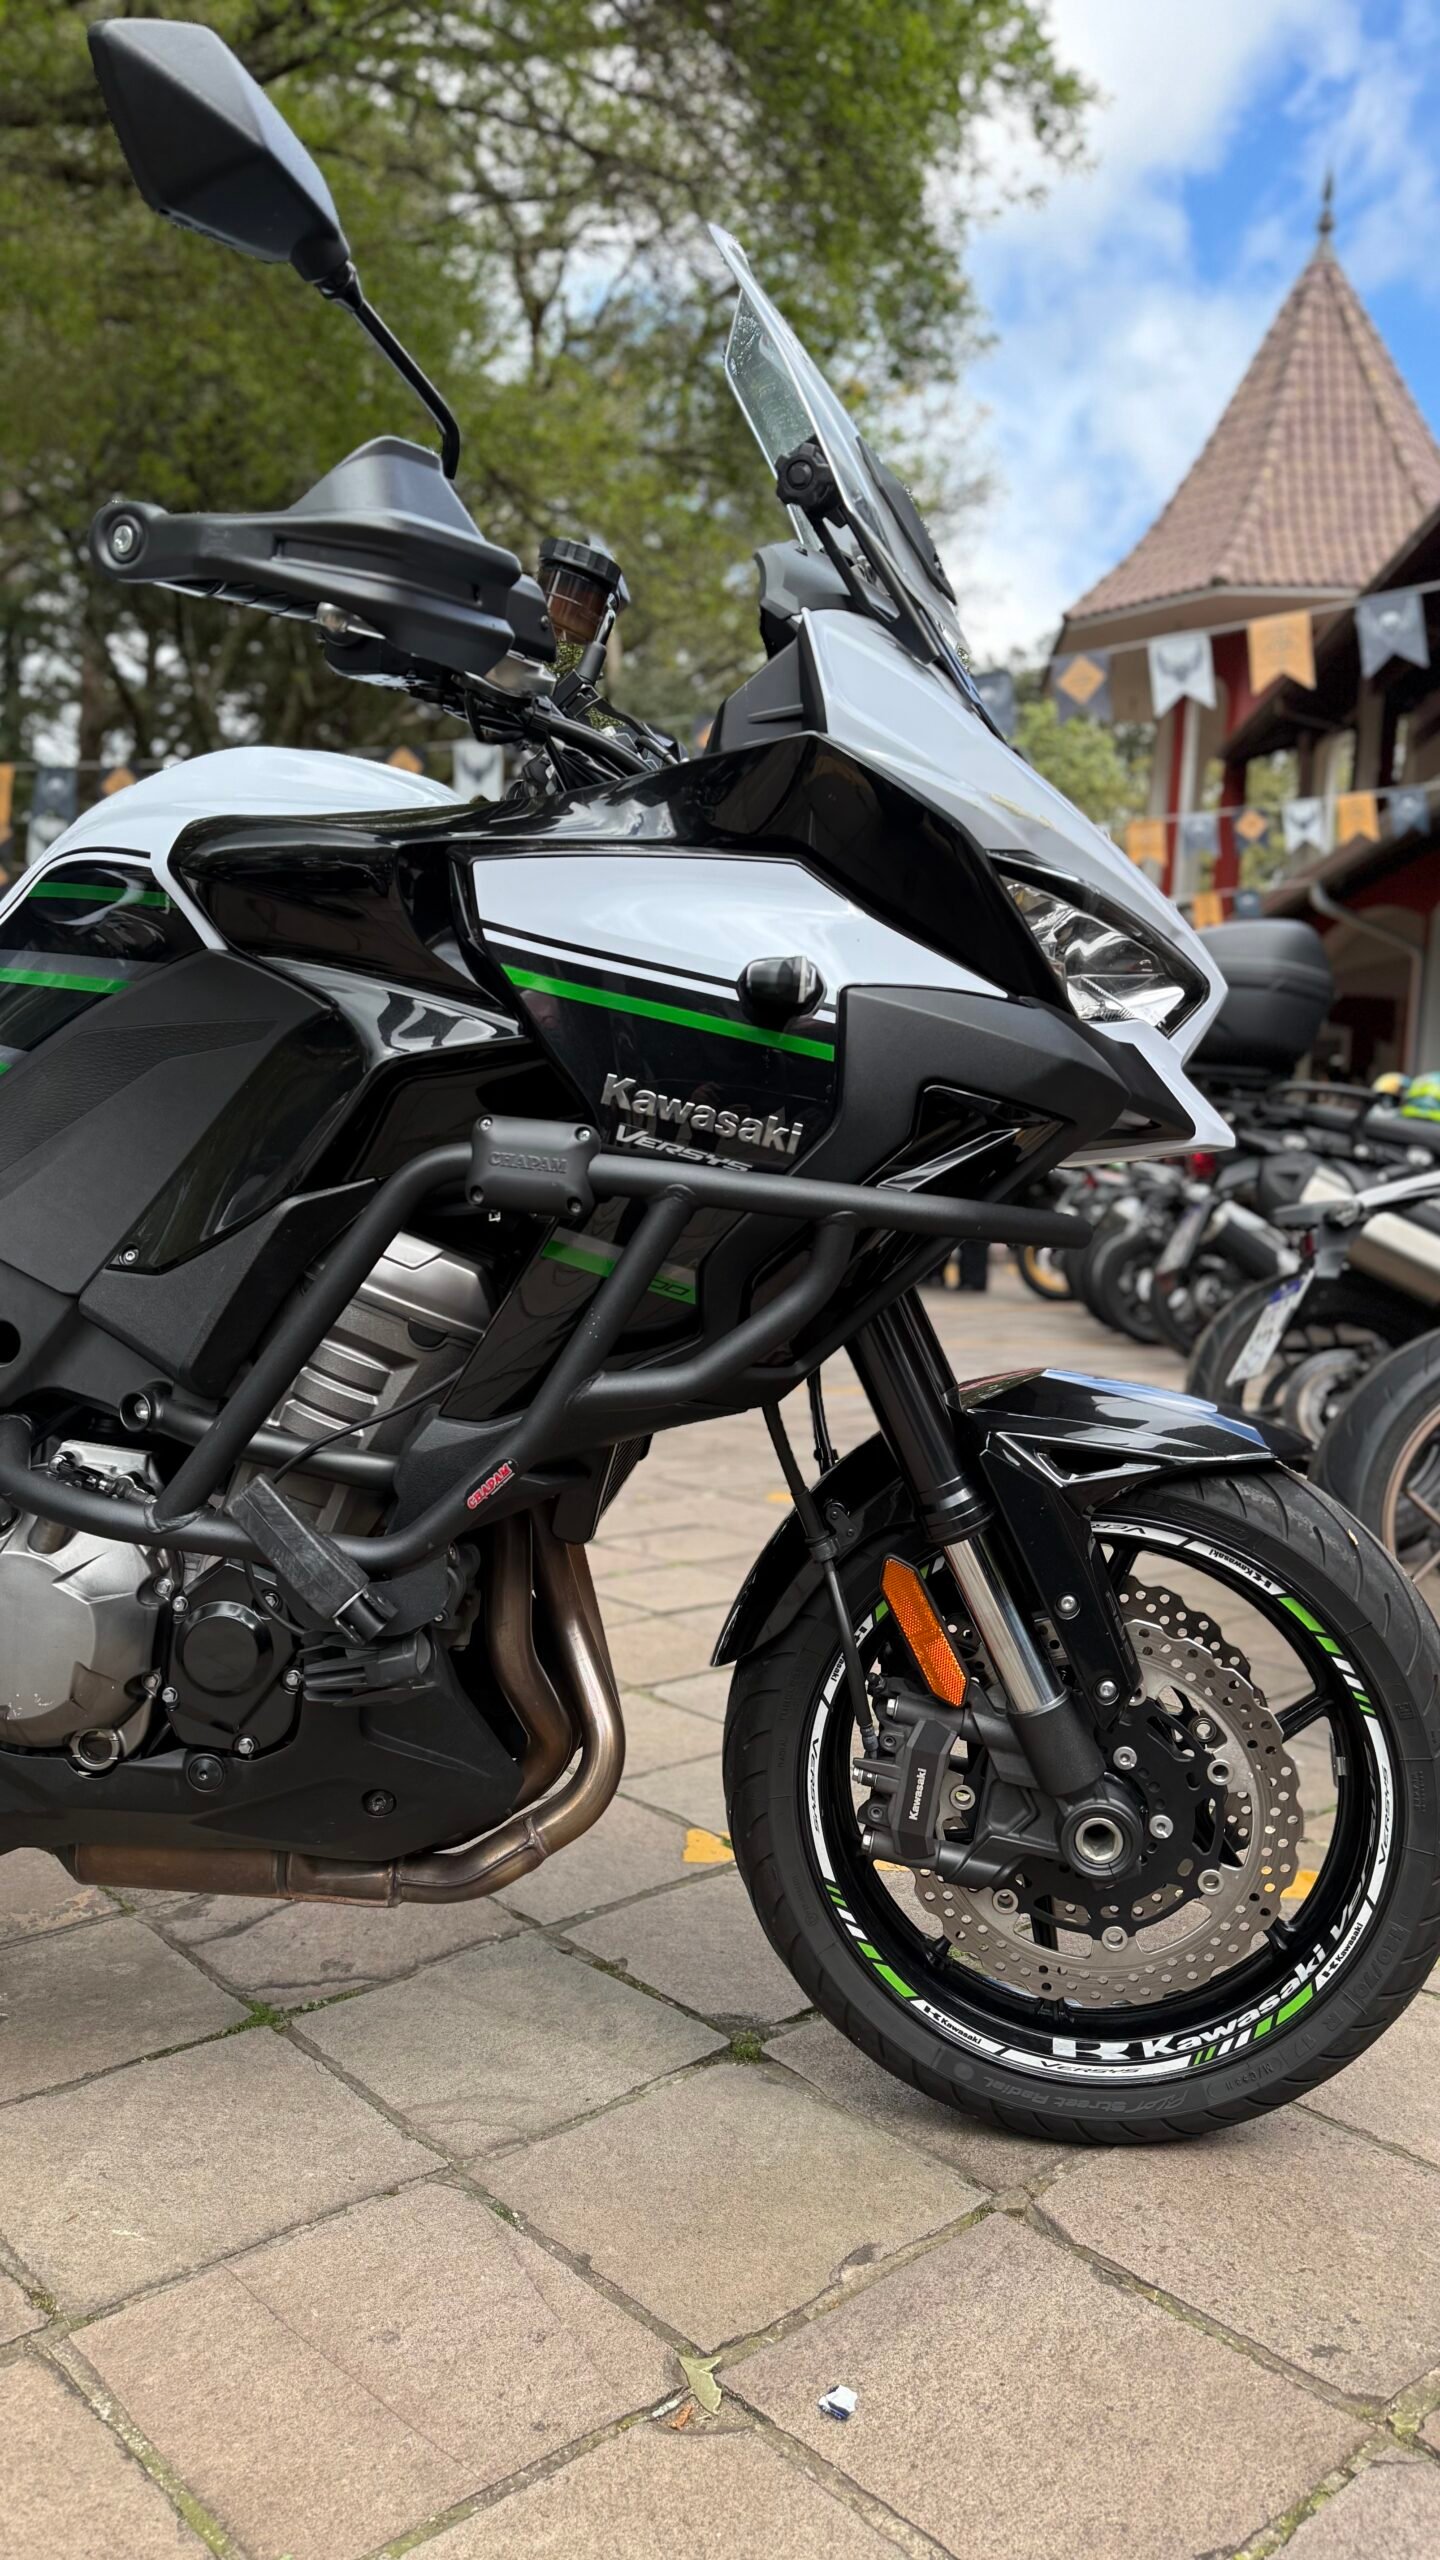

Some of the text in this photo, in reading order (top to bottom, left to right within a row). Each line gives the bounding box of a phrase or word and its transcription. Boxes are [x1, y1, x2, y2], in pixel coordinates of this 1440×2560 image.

[601, 1072, 804, 1155] Kawasaki
[488, 1151, 568, 1175] CHAPAM
[615, 1122, 753, 1172] VERSYS
[466, 1462, 513, 1510] CHAPAM
[1208, 1548, 1252, 1577] Kawasaki
[908, 1767, 927, 1821] Kawasaki
[1337, 1922, 1364, 1962] Kawasaki
[1141, 1943, 1327, 2059] Kawasaki
[940, 2018, 982, 2046] Kawasaki
[1053, 2096, 1127, 2113] Street
